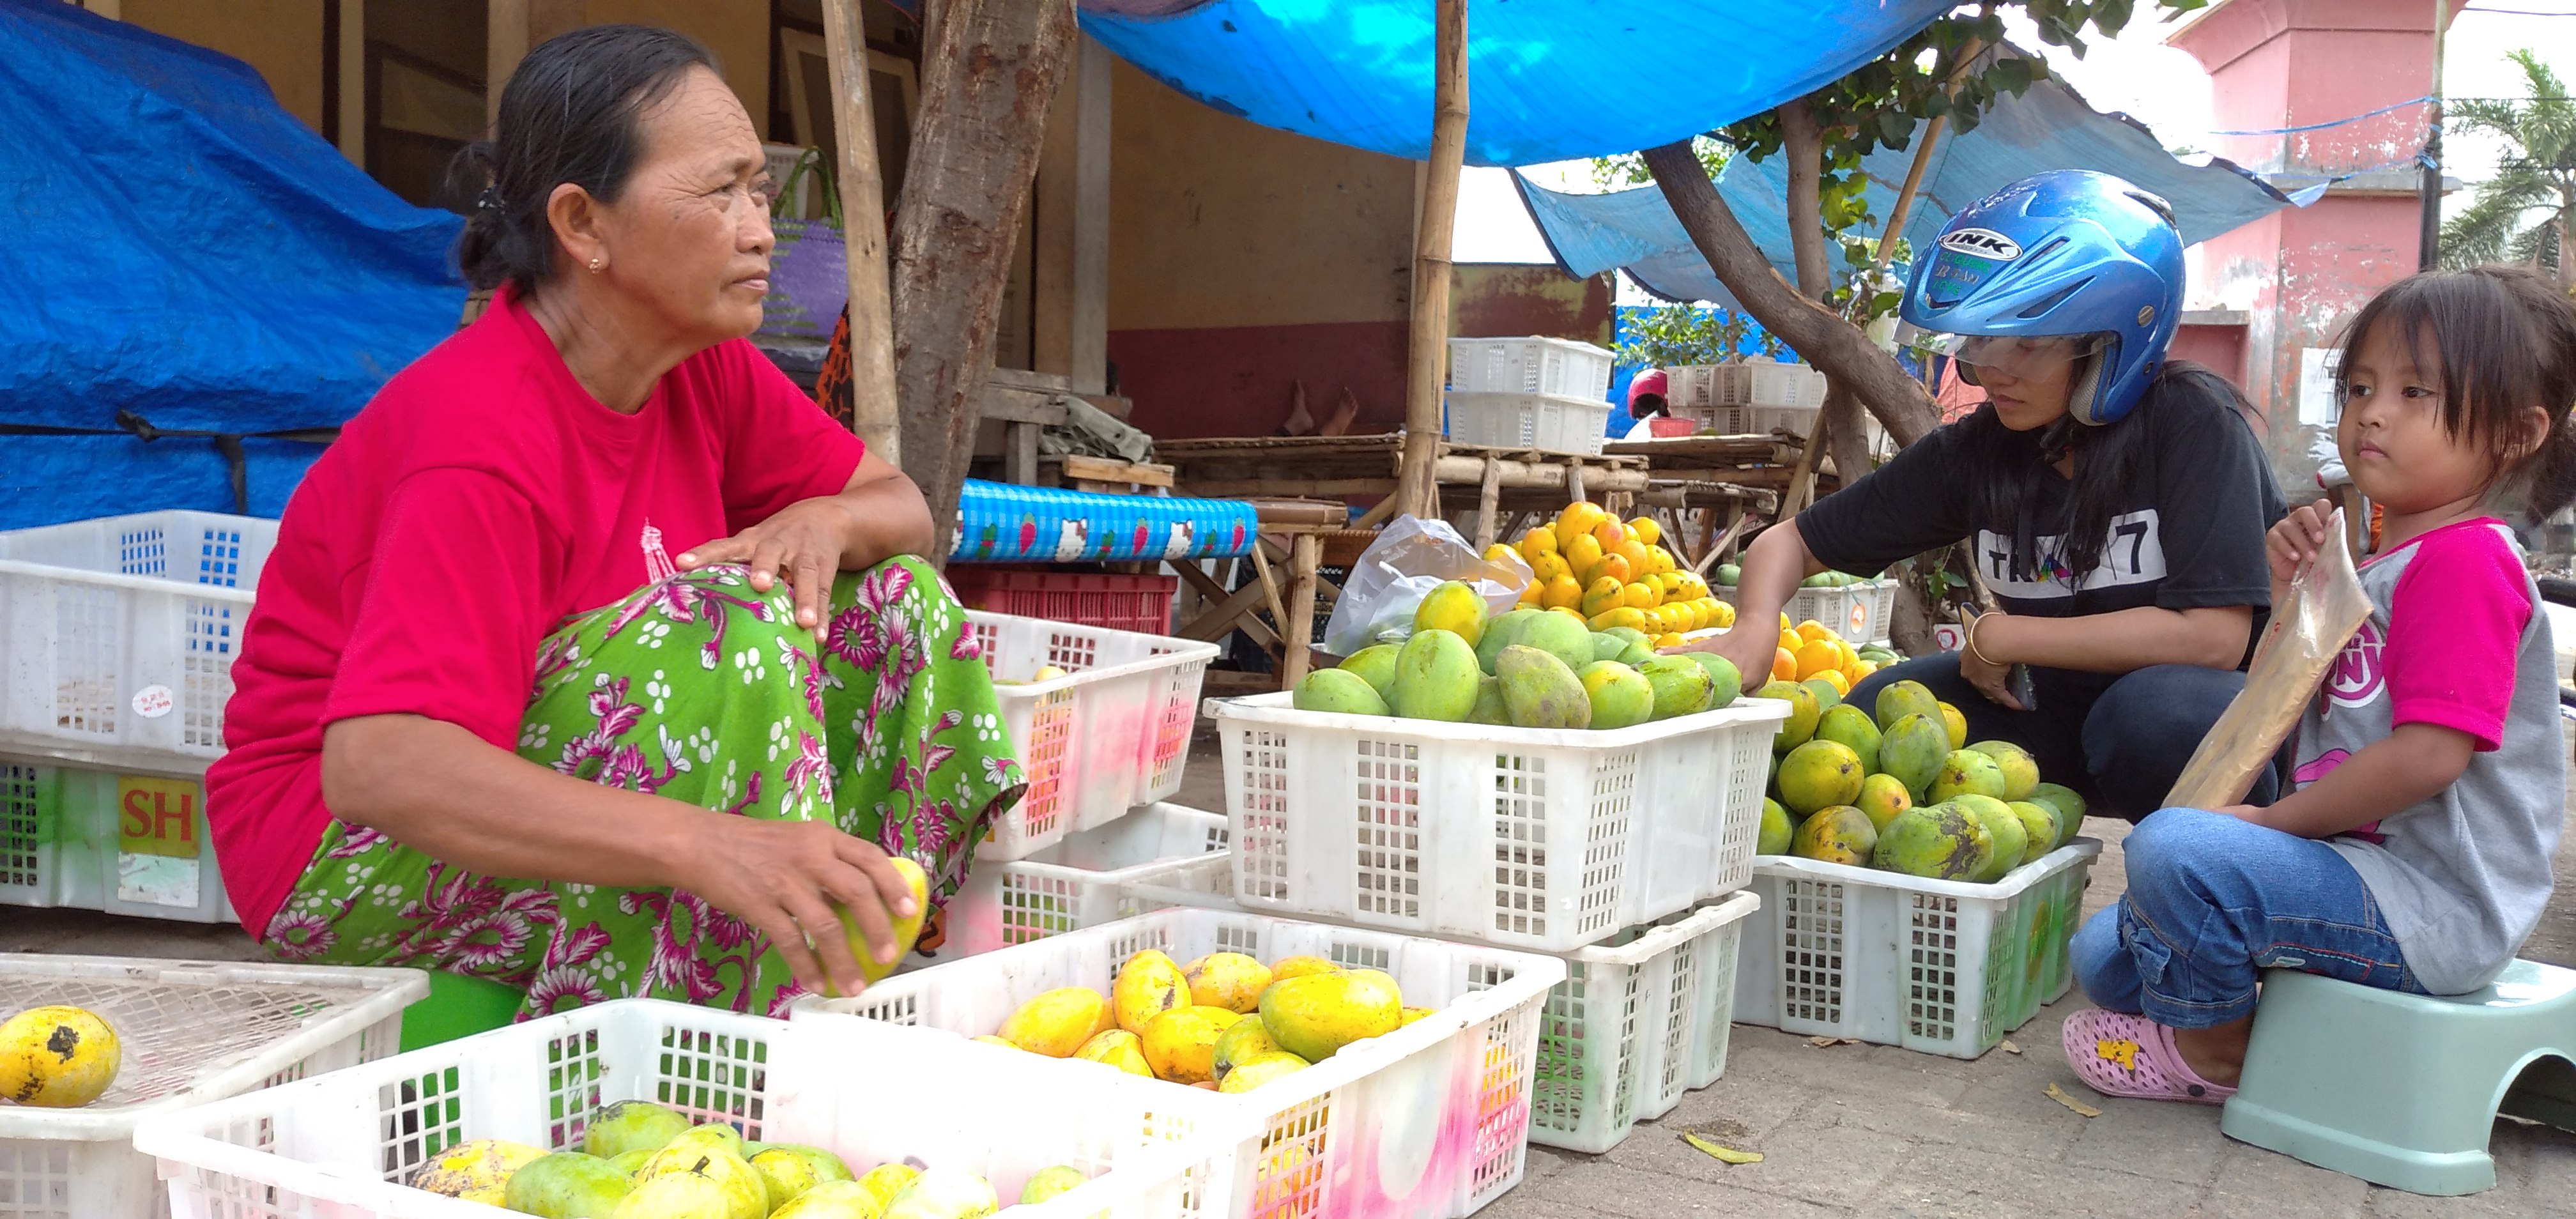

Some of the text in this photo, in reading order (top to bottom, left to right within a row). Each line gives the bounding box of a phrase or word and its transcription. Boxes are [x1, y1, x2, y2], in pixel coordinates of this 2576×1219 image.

[1947, 233, 2016, 255] INK
[2115, 520, 2149, 576] 7
[123, 788, 192, 842] SH
